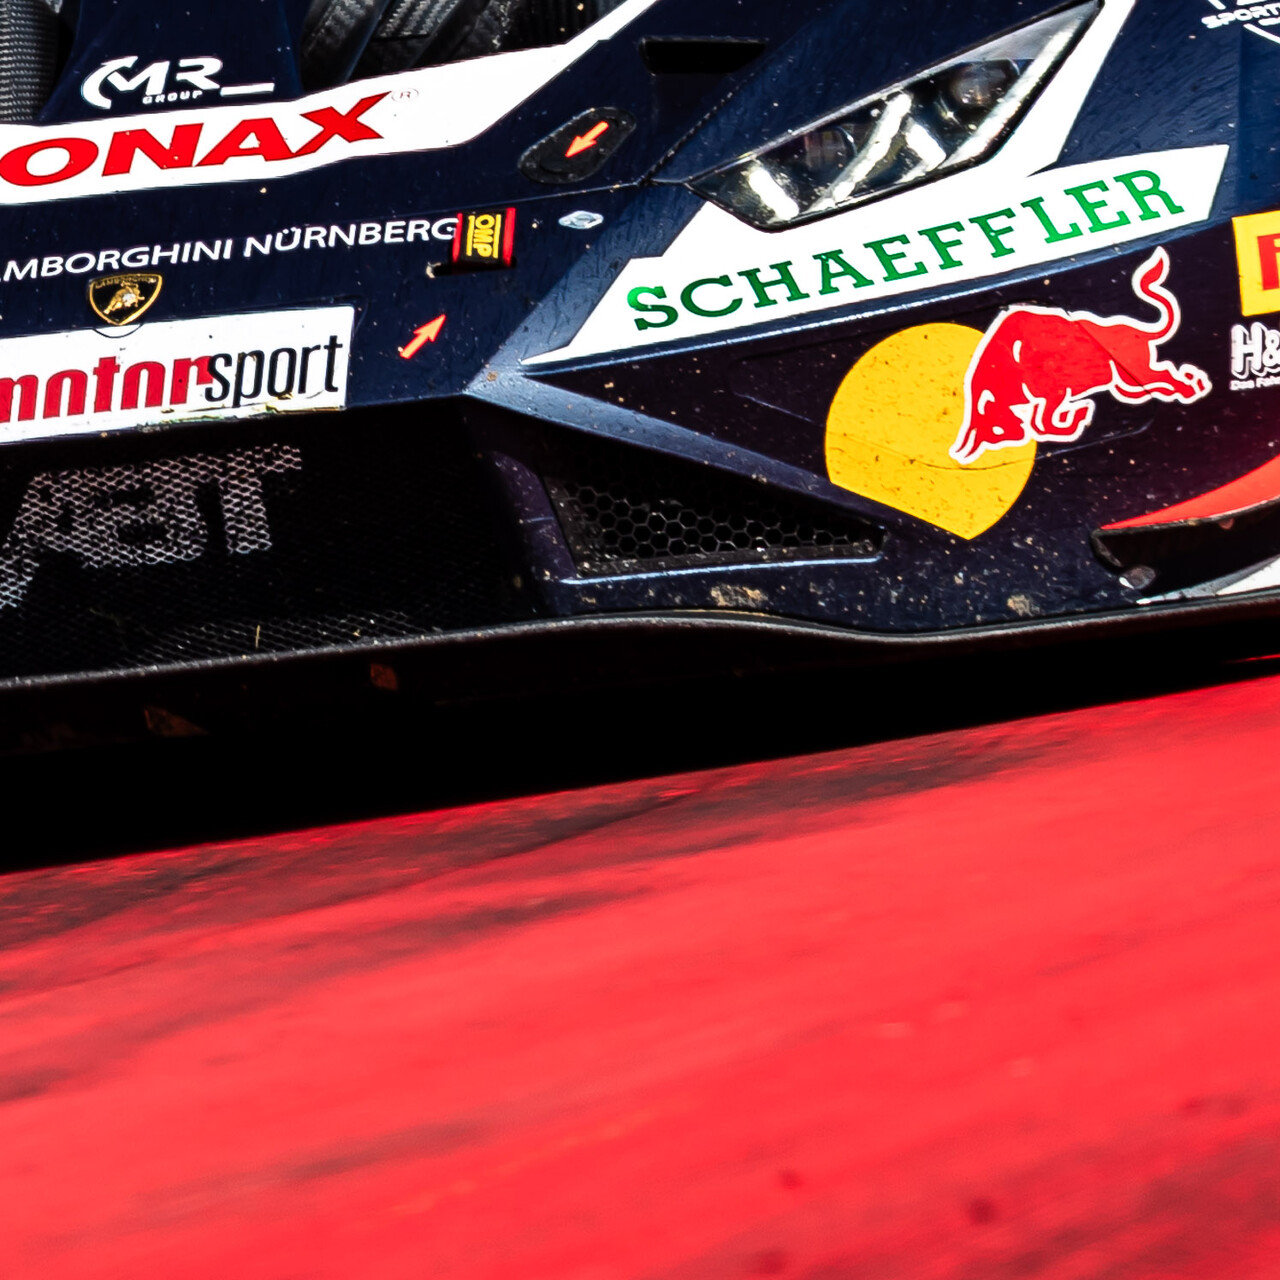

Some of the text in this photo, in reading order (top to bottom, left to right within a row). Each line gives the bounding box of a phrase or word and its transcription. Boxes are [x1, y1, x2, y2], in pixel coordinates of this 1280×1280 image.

[142, 90, 204, 104] GROUP
[243, 218, 460, 258] NÜRNBERG
[472, 214, 496, 258] OMP
[628, 170, 1185, 331] SCHAEFFLER
